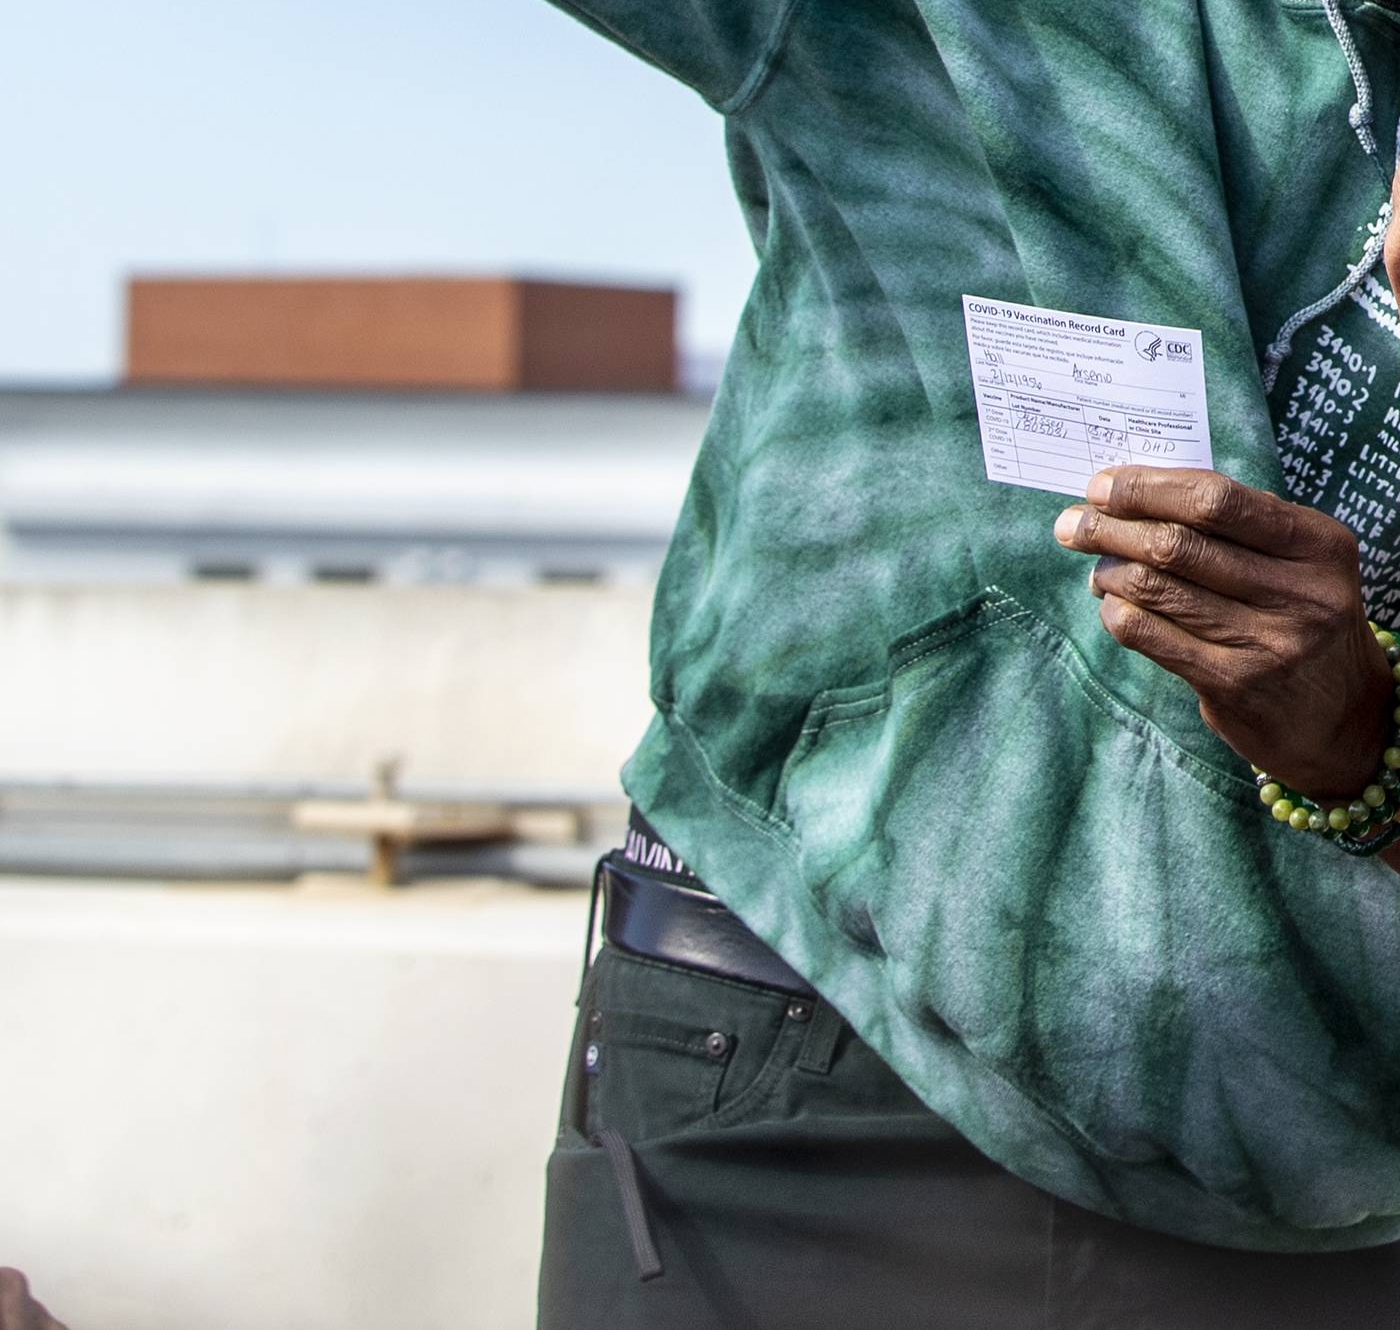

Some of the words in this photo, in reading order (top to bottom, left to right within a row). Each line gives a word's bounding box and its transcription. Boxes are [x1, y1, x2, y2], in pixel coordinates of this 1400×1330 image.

[969, 302, 1012, 319] COVID-19
[1013, 311, 1067, 327] Vaccination
[1068, 320, 1101, 333] Record
[1103, 325, 1125, 337] Card
[1167, 342, 1190, 355] CDC
[1072, 362, 1112, 384] Arsenio
[1338, 479, 1397, 524] LITTLE
